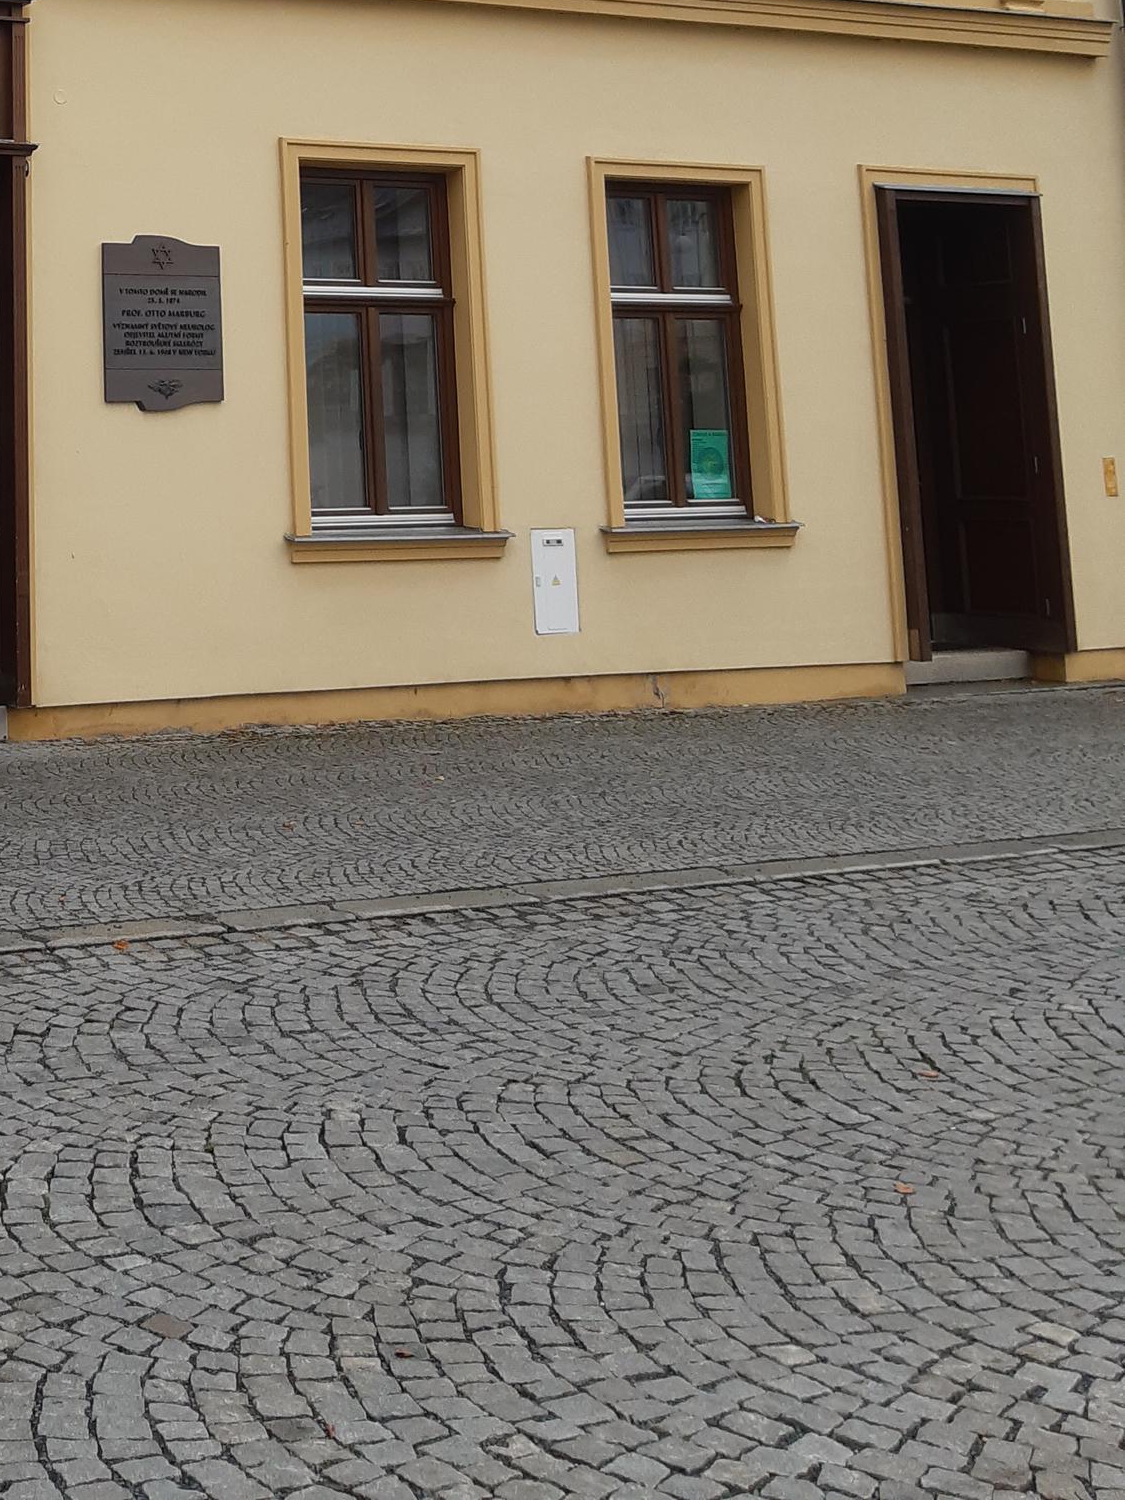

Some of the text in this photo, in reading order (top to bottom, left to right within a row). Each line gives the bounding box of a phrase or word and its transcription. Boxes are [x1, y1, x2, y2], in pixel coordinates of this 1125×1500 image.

[121, 309, 206, 318] PROF. OTTO MARBURG
